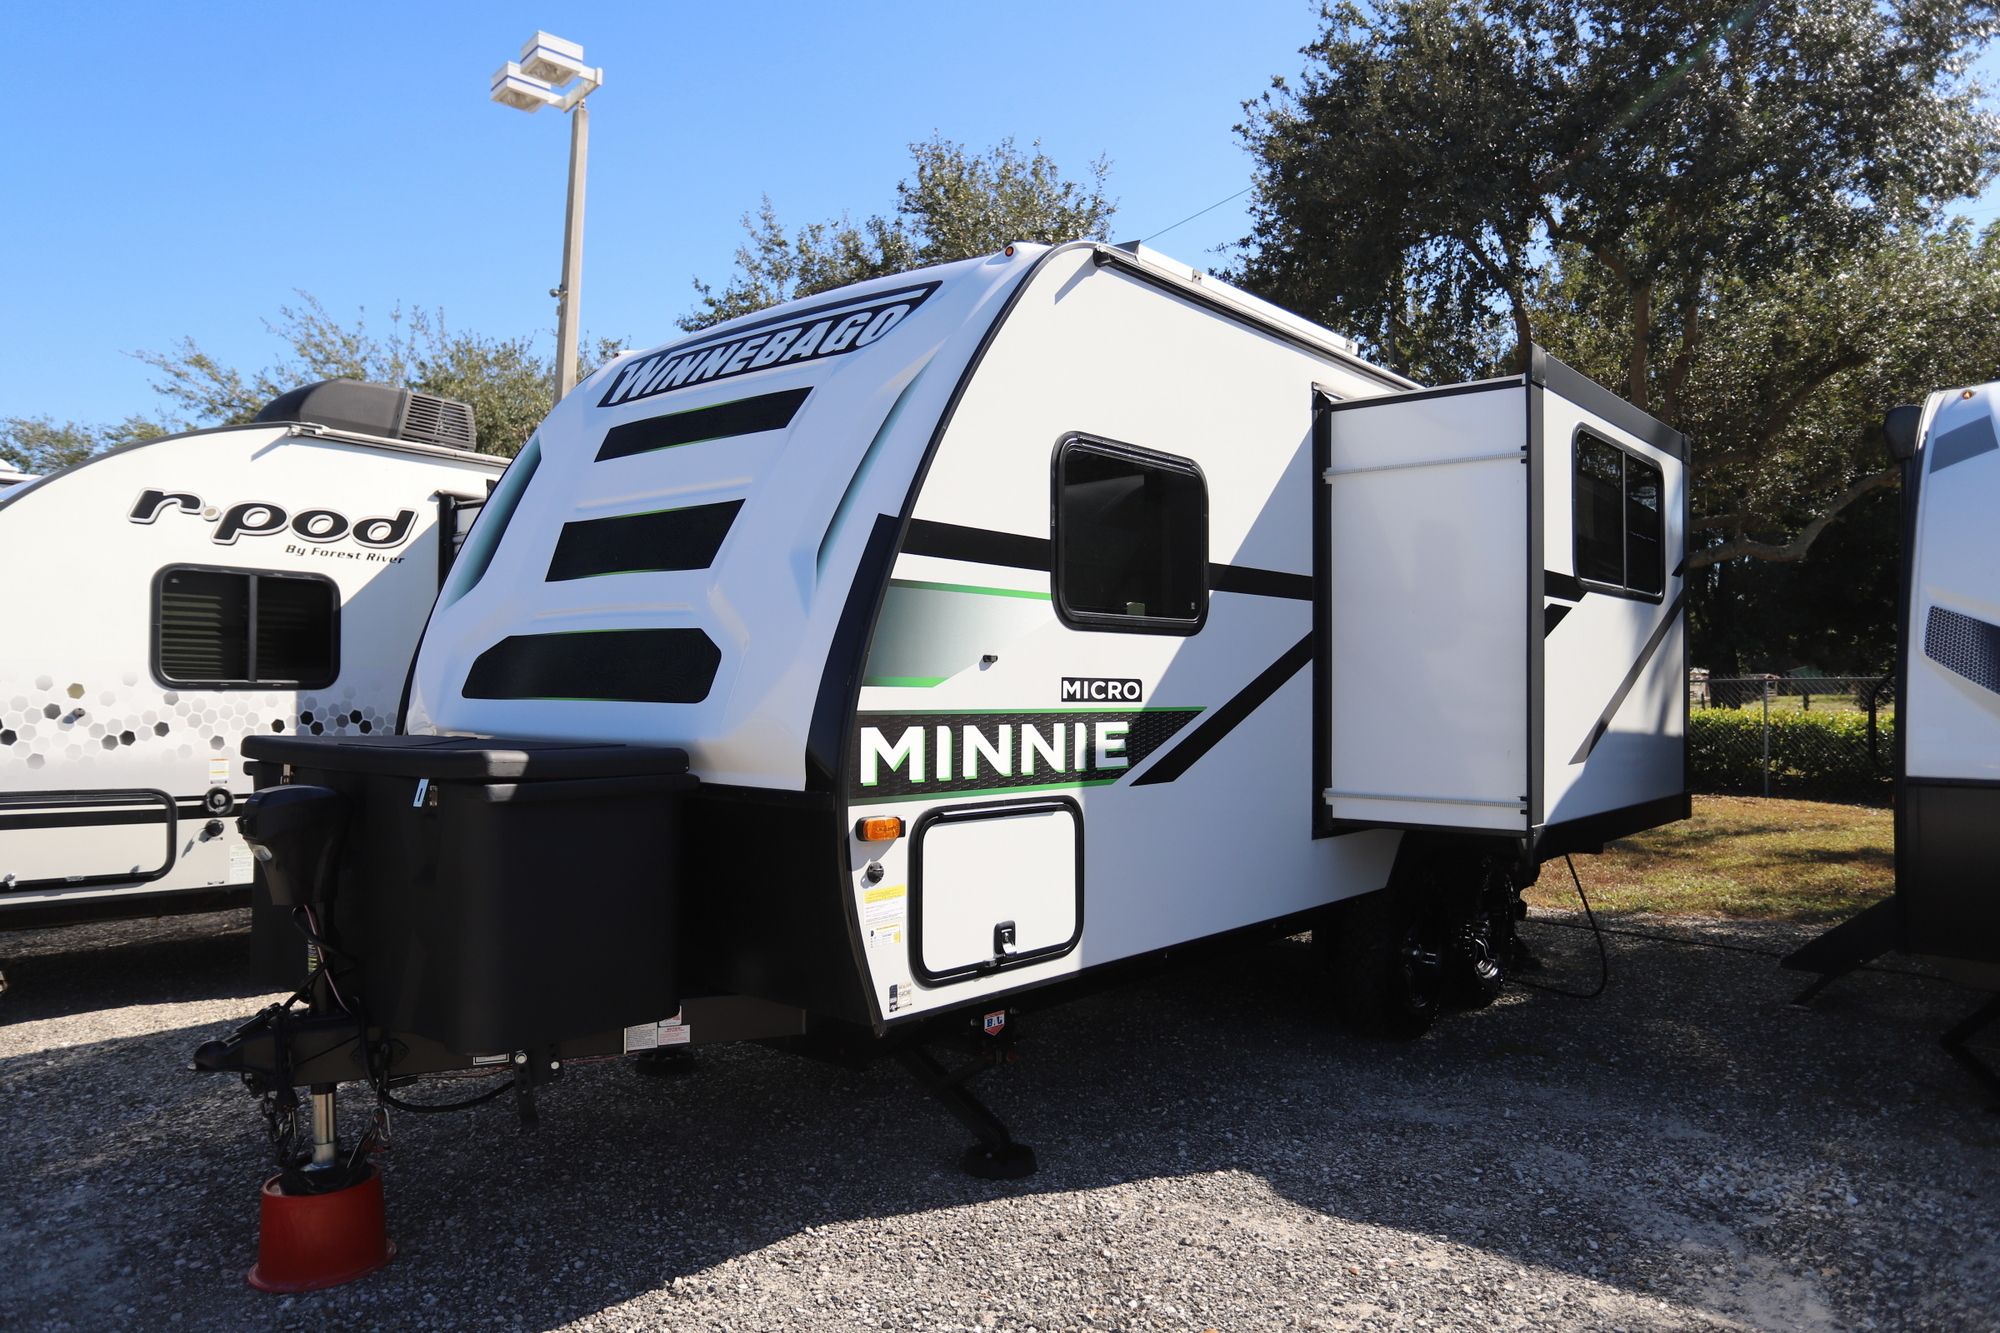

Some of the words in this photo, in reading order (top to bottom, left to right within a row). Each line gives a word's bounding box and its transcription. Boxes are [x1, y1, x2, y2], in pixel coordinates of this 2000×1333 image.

[608, 304, 910, 404] WINNEBAGO
[285, 544, 306, 556] By
[311, 547, 361, 560] Forest
[366, 552, 405, 564] River
[1062, 680, 1141, 700] MICRO
[860, 721, 1129, 786] MINNIE
